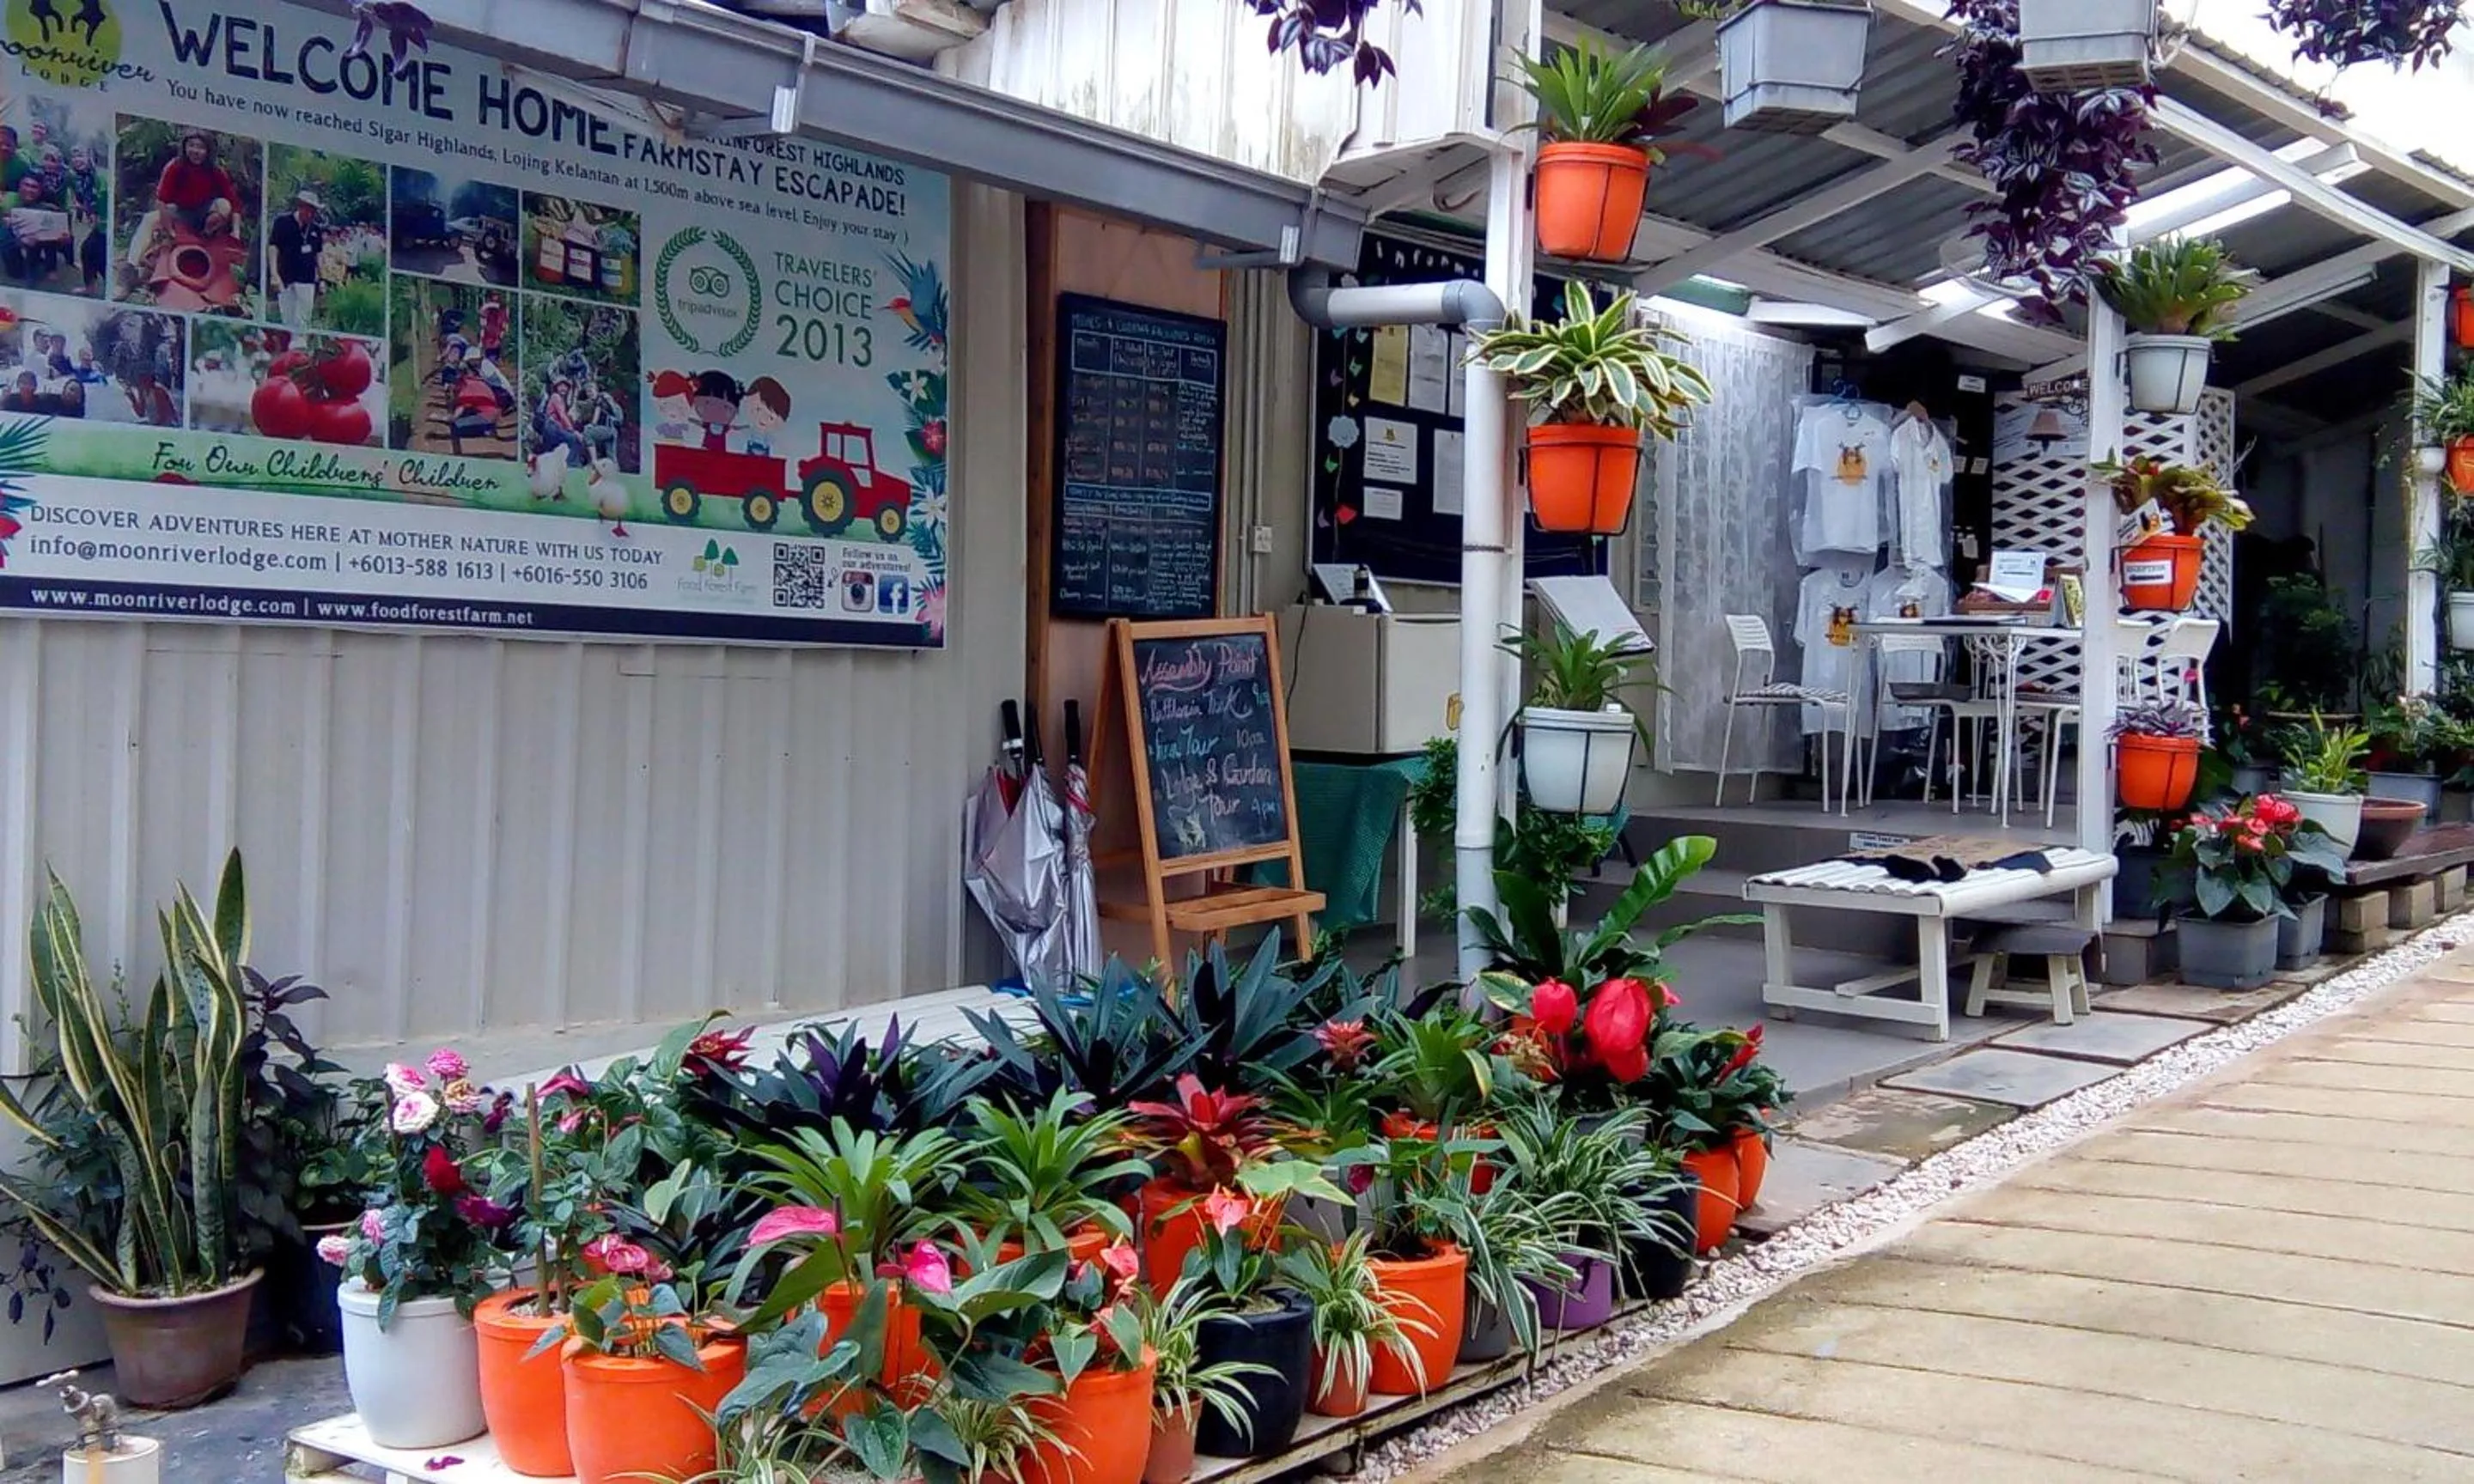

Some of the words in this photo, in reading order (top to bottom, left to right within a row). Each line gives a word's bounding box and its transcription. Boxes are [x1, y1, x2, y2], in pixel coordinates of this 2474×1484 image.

[0, 40, 155, 82] oonriver
[159, 0, 454, 121] WELCOME
[478, 75, 617, 155] HOME
[167, 79, 198, 100] You
[204, 87, 246, 110] have
[253, 101, 288, 119] now
[296, 110, 363, 133] reached
[369, 121, 410, 144] Sigar
[417, 133, 497, 163] Highlands,
[503, 148, 550, 175] Lojing
[555, 159, 618, 186] Kelantan
[625, 179, 639, 190] at
[694, 190, 734, 210] above
[739, 198, 760, 214] sea
[803, 210, 837, 233] Enjoy
[842, 222, 868, 235] your
[873, 227, 897, 244] stay
[624, 134, 763, 185] FARMSTAY
[776, 167, 905, 216] ESCAPADE!
[813, 149, 905, 186] HIGHLANDS
[775, 280, 872, 319] CHOICE
[776, 314, 871, 368] 2013
[151, 441, 194, 471] For
[205, 444, 259, 472] Our
[399, 458, 501, 491] Children
[30, 505, 139, 529] DISCOVER
[149, 514, 283, 538] ADVENTURES
[291, 525, 341, 544] HERE
[348, 529, 371, 544] AT
[379, 531, 454, 550] MOTHER
[460, 537, 528, 556] NATURE
[536, 542, 578, 560] WITH
[584, 545, 604, 561] US
[610, 547, 662, 566] TODAY
[30, 535, 326, 570] info@moonriverlodge.com
[348, 556, 448, 577] +6013-588
[457, 563, 493, 581] 1613
[512, 566, 602, 587] +6016-550
[611, 571, 648, 590] 3106
[31, 588, 296, 616] www.moonriverlodge.com
[317, 602, 534, 625] www.foodforestfarm.net
[1214, 642, 1259, 684] Point
